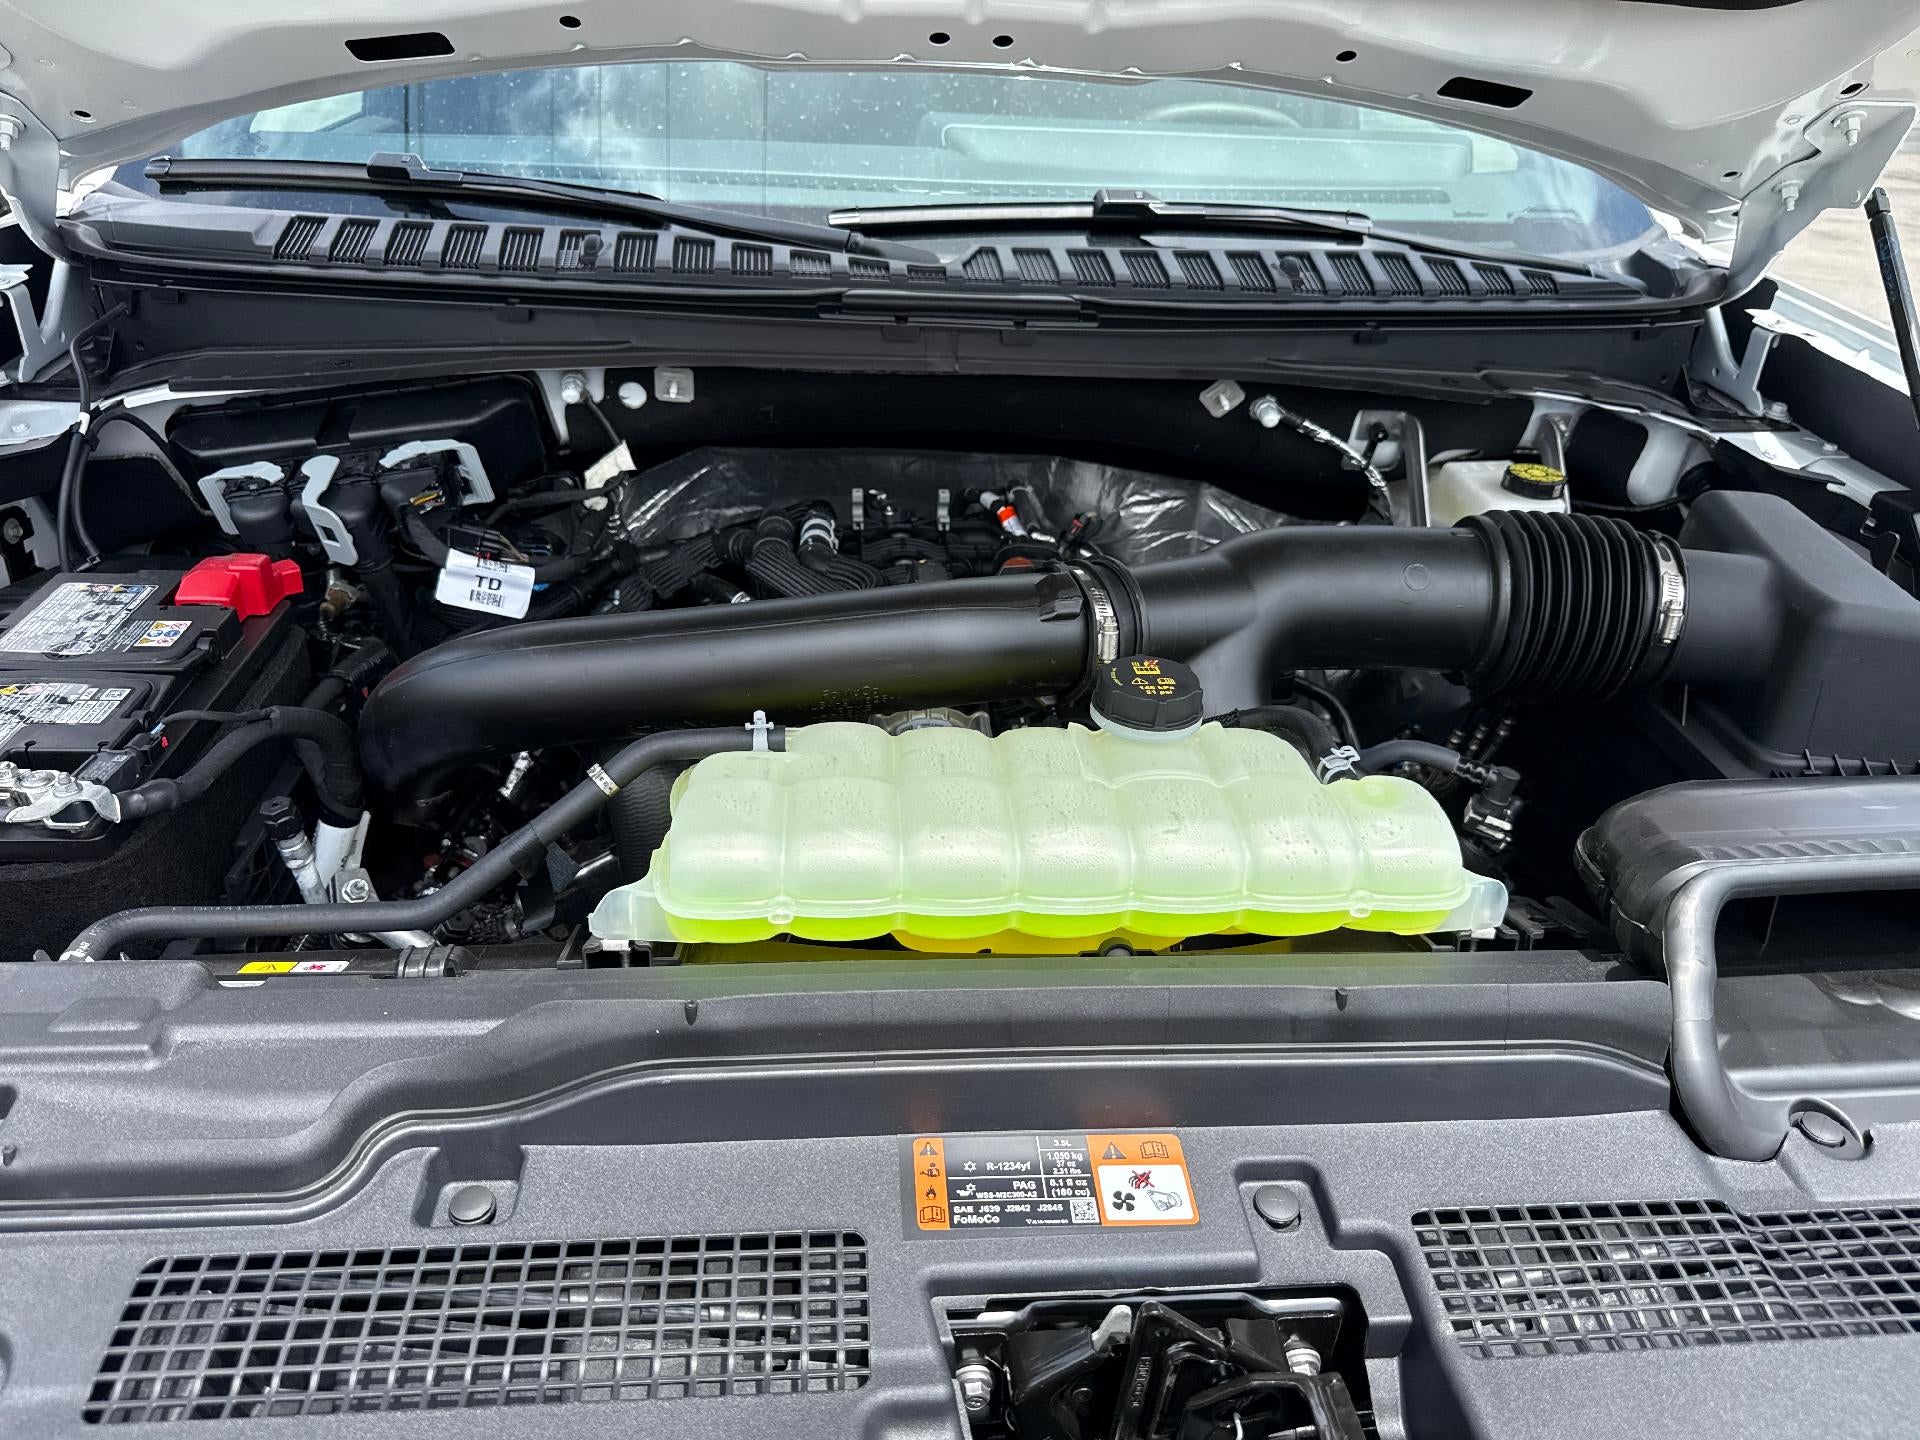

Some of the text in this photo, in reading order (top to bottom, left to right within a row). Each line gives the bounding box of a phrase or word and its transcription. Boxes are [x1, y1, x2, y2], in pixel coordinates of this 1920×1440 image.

[475, 574, 503, 591] TD
[1053, 1139, 1072, 1147] 3.5L
[1047, 1151, 1083, 1162] 1.050 kg
[986, 1161, 1031, 1172] R-1234yf
[1066, 1160, 1077, 1168] oz
[1069, 1167, 1082, 1175] lbs
[1012, 1180, 1037, 1190] PAG
[1075, 1179, 1088, 1187] oz
[1074, 1187, 1091, 1198] cc)
[953, 1203, 1064, 1214] SAE J639 J2842 J2845
[953, 1214, 1000, 1225] FoMoCo
